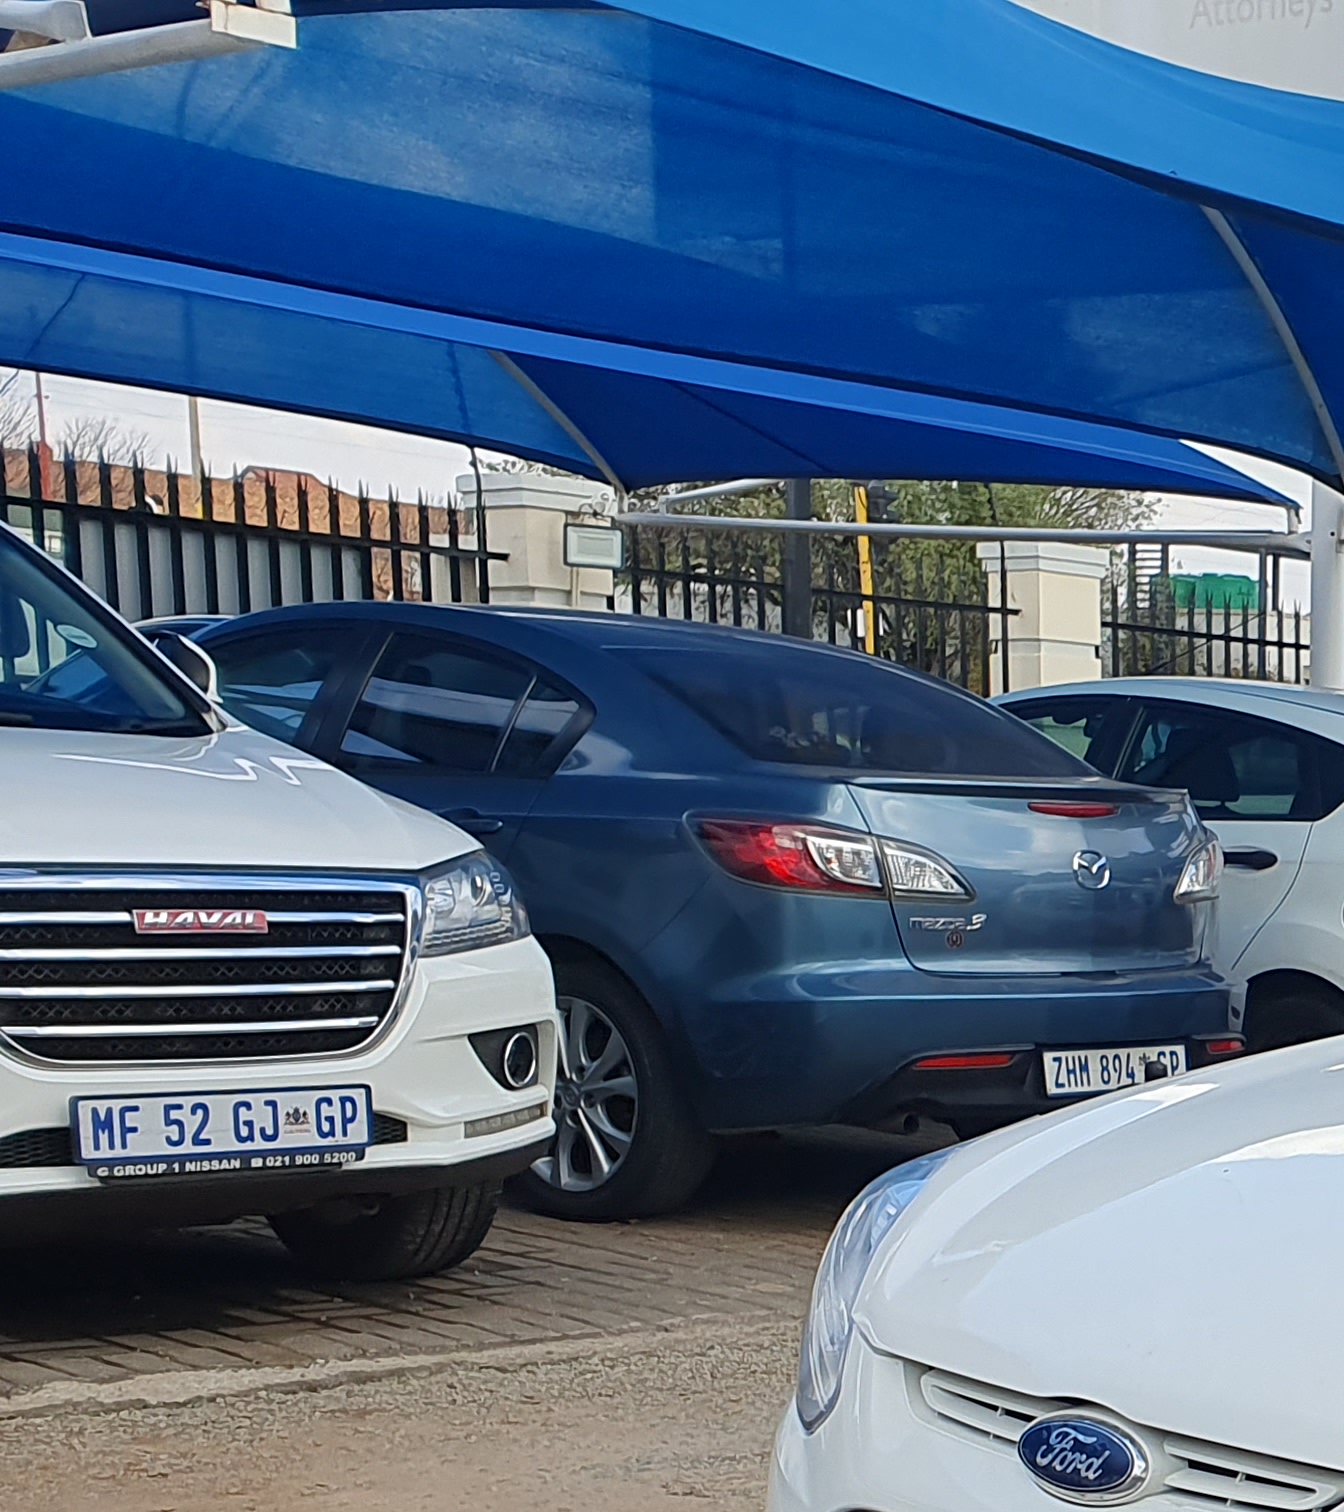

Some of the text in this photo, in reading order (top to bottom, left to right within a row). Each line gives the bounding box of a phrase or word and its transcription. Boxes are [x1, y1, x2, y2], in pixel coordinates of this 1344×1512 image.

[143, 910, 264, 929] HAVAL
[1052, 1055, 1091, 1088] ZHM
[1100, 1052, 1135, 1085] 894
[91, 1096, 358, 1151] MF 52 GJ GP
[113, 1162, 167, 1177] GROUP
[185, 1158, 241, 1172] NISSAN
[266, 1155, 290, 1168] 021
[295, 1153, 319, 1165] 900
[324, 1151, 356, 1164] 5200
[1036, 1426, 1109, 1482] Ford
